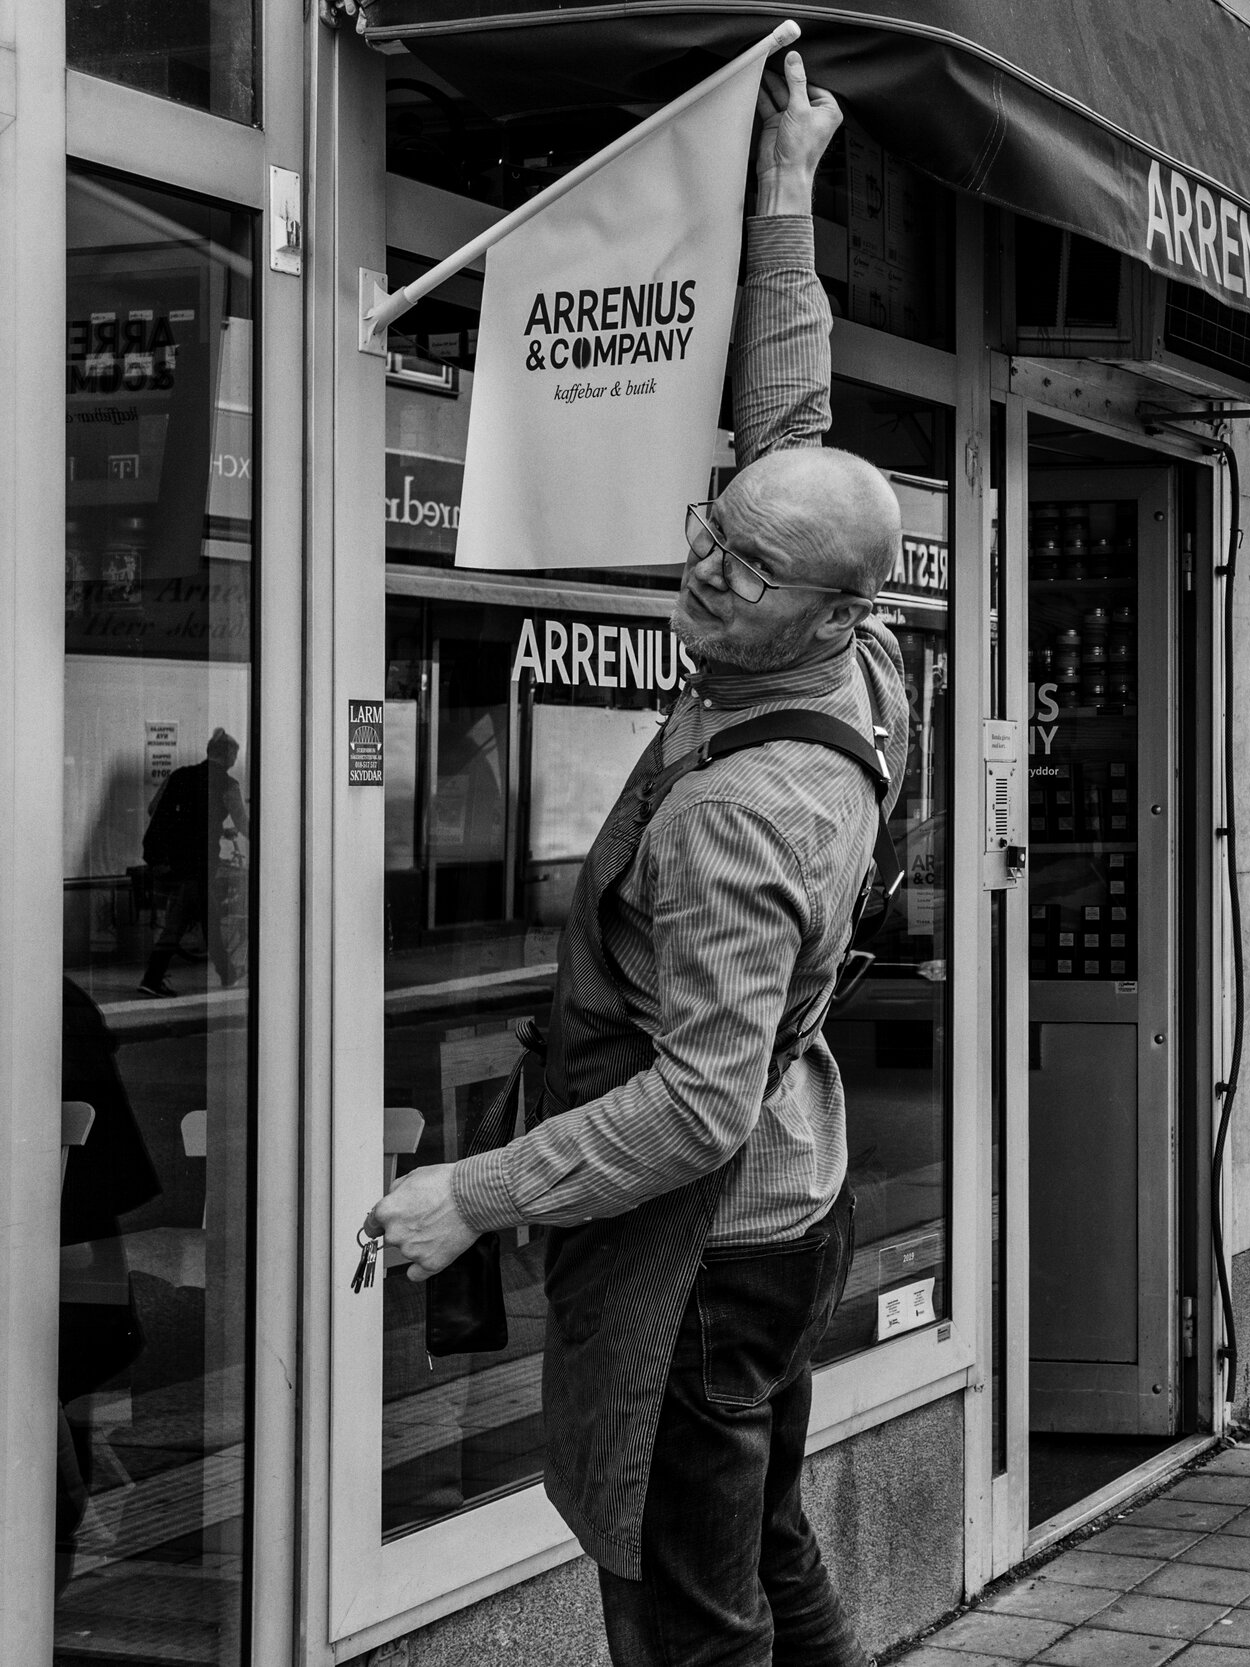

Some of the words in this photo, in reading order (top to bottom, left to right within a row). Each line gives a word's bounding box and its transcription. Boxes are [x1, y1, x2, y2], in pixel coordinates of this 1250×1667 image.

[523, 279, 696, 336] ARRENIUS
[553, 383, 608, 404] kaffebar
[610, 381, 621, 397] &
[625, 378, 656, 396] butik
[510, 618, 697, 691] ARRENIUS
[350, 705, 382, 723] LARM
[350, 769, 382, 781] SKYDDAR
